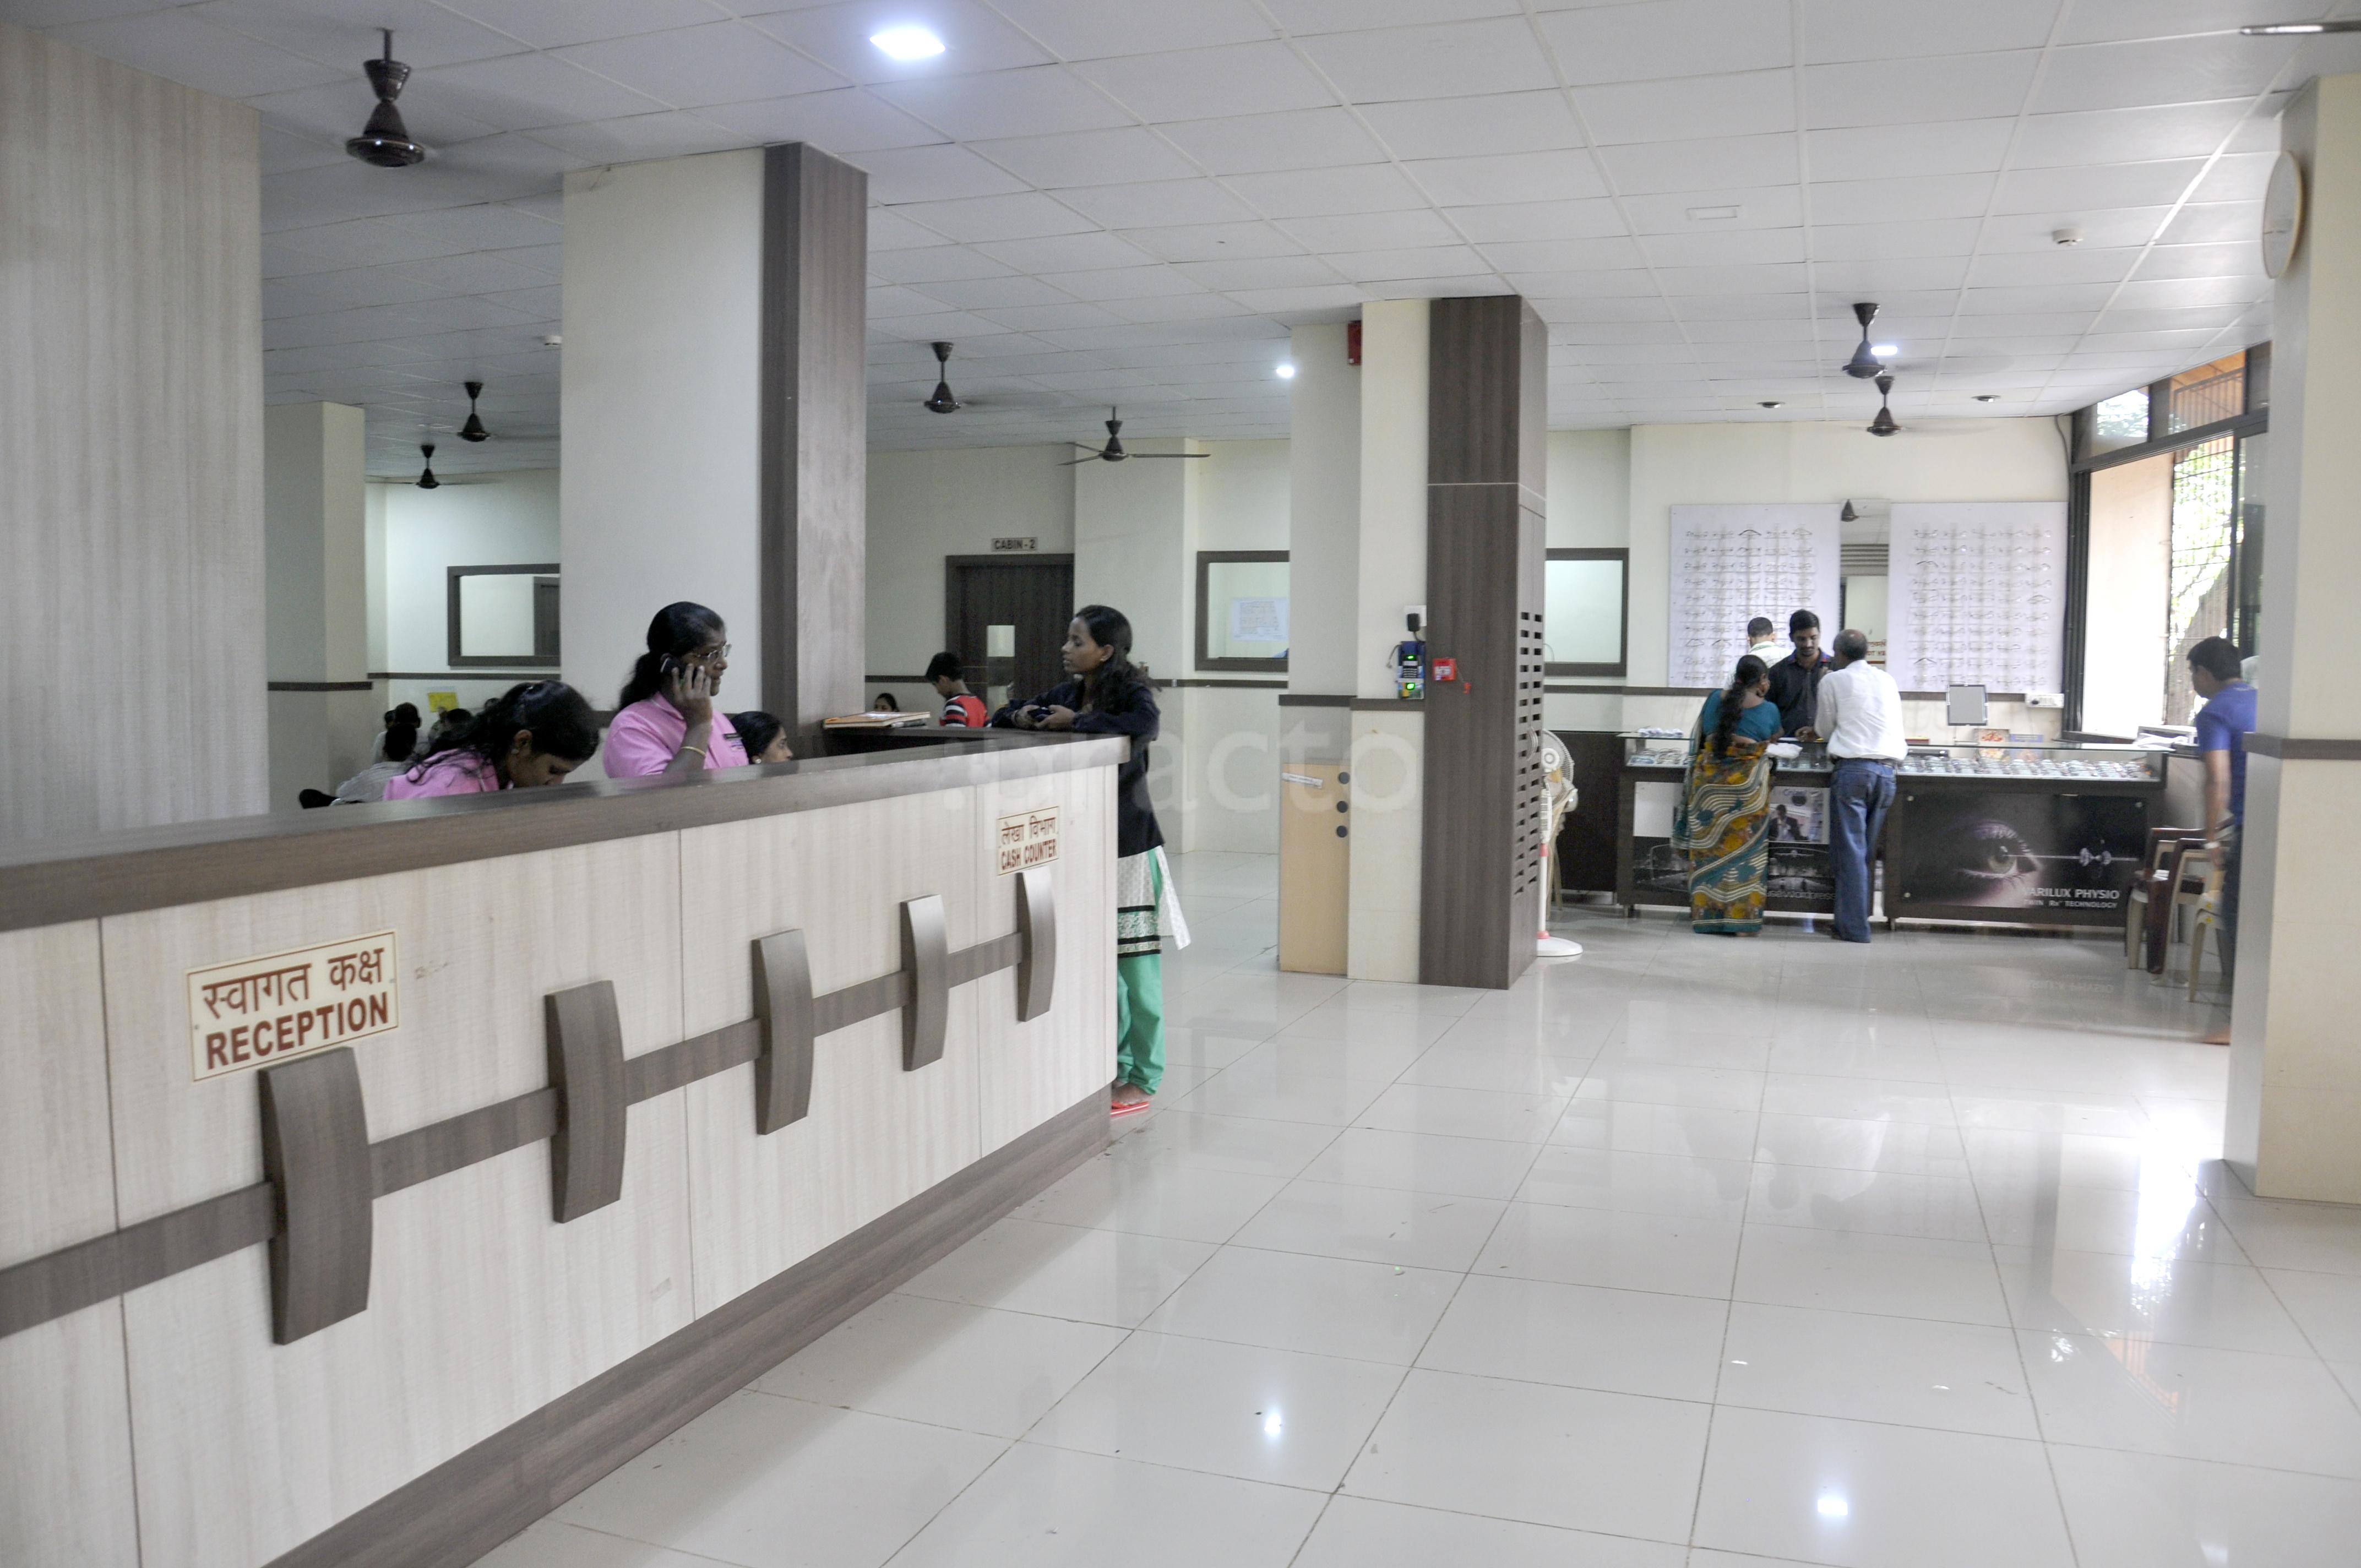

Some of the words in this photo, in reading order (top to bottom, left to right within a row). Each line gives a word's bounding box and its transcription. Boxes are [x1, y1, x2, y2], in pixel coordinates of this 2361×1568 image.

[995, 540, 1022, 549] CABIN
[1030, 539, 1036, 549] 2
[1001, 821, 1025, 845] लेखा
[1001, 847, 1021, 870] CASH
[1024, 839, 1057, 864] COUNTER
[2075, 889, 2120, 899] PHYSIO
[202, 962, 312, 1020] स्वागत
[328, 947, 385, 991] कक्ष
[206, 991, 388, 1070] RECEPTION
